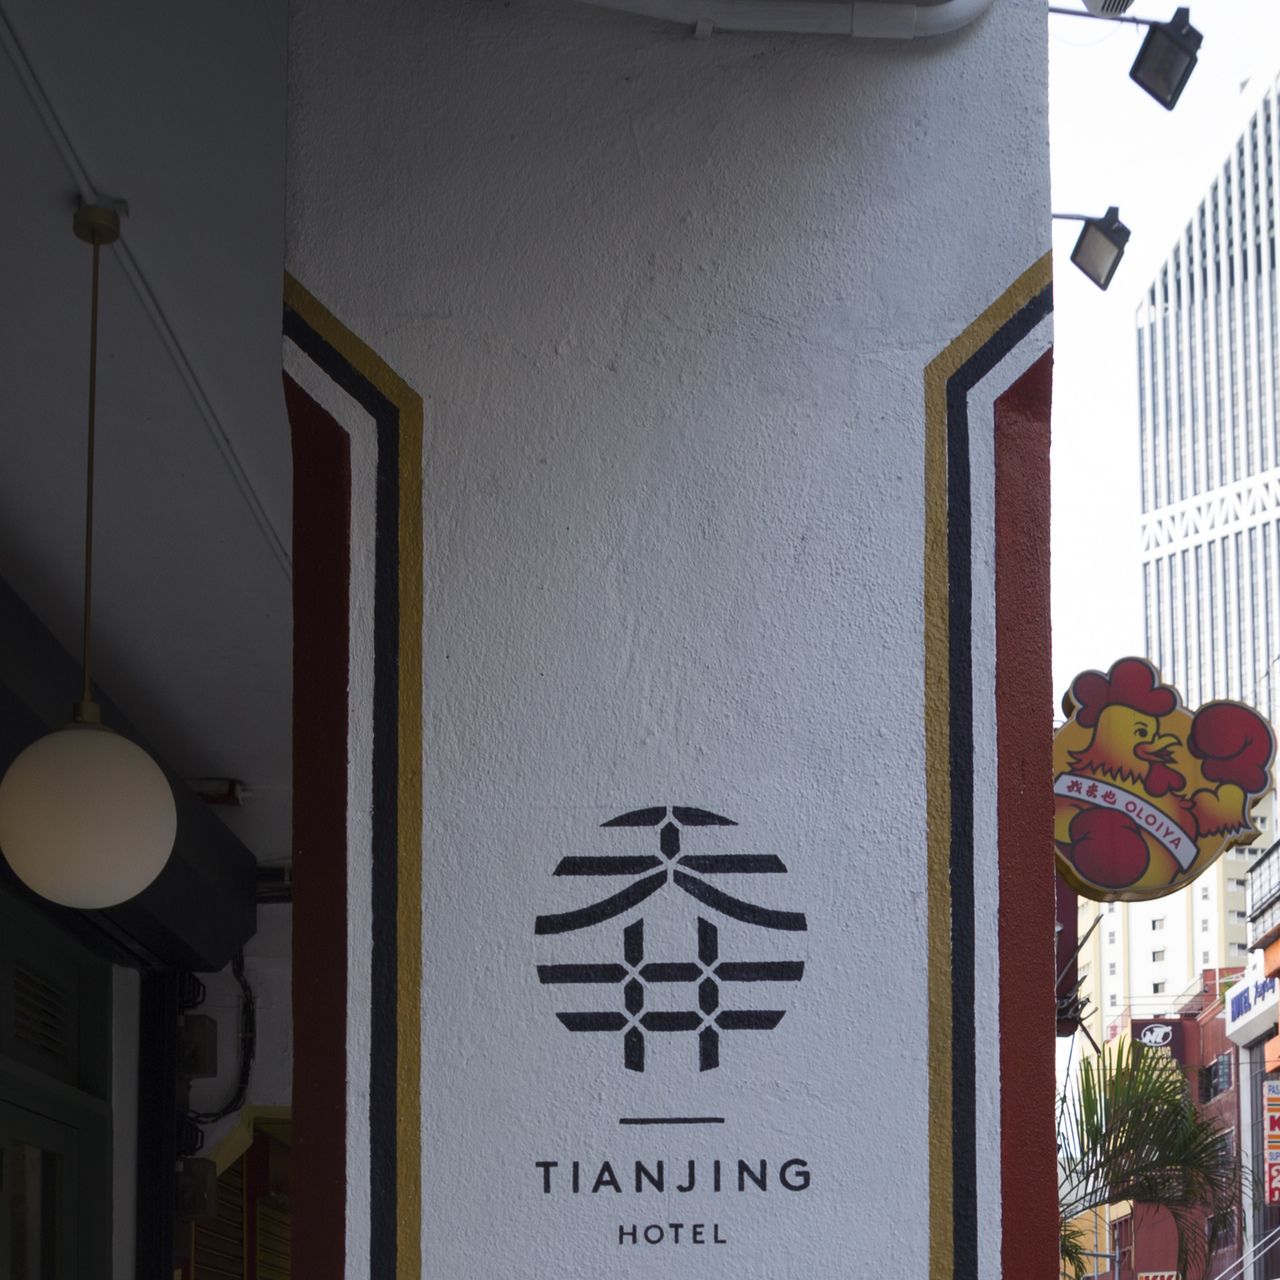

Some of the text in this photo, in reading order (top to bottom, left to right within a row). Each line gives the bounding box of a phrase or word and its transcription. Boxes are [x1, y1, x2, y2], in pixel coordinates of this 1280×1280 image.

[1125, 801, 1183, 850] OLOIYA
[534, 1157, 813, 1195] TIANJING
[617, 1222, 728, 1245] HOTEL
